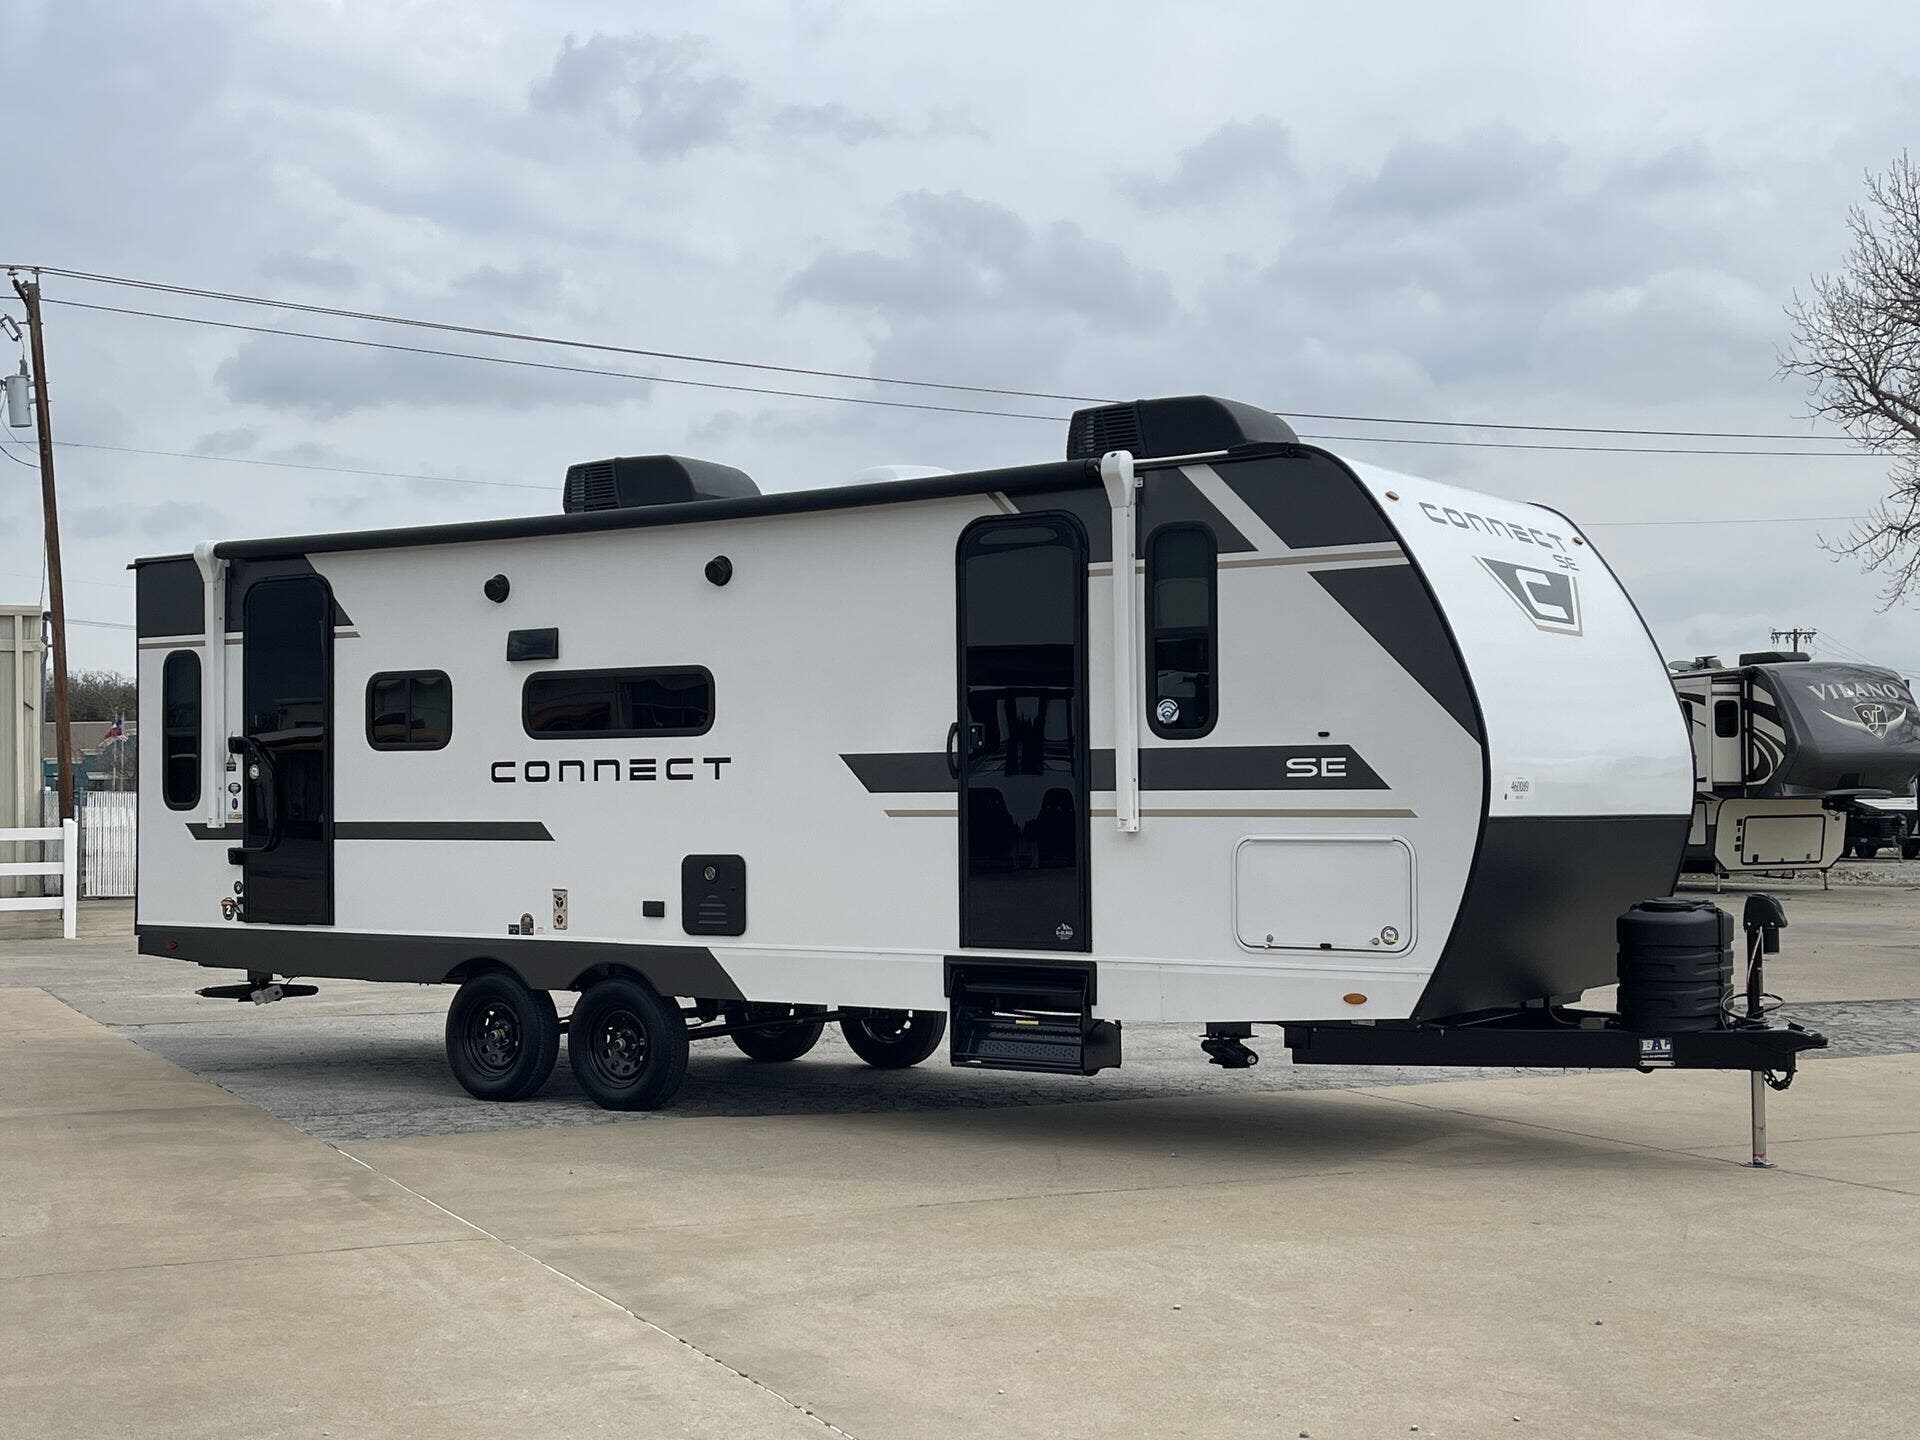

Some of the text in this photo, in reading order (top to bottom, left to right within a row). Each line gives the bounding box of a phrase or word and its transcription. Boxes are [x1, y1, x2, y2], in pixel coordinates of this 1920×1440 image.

[1418, 502, 1567, 552] CONNECT
[1552, 554, 1580, 571] SE
[1807, 683, 1900, 701] VILANO
[491, 757, 732, 783] CONNECT
[1286, 757, 1347, 777] SE
[1641, 1039, 1671, 1051] BAL
